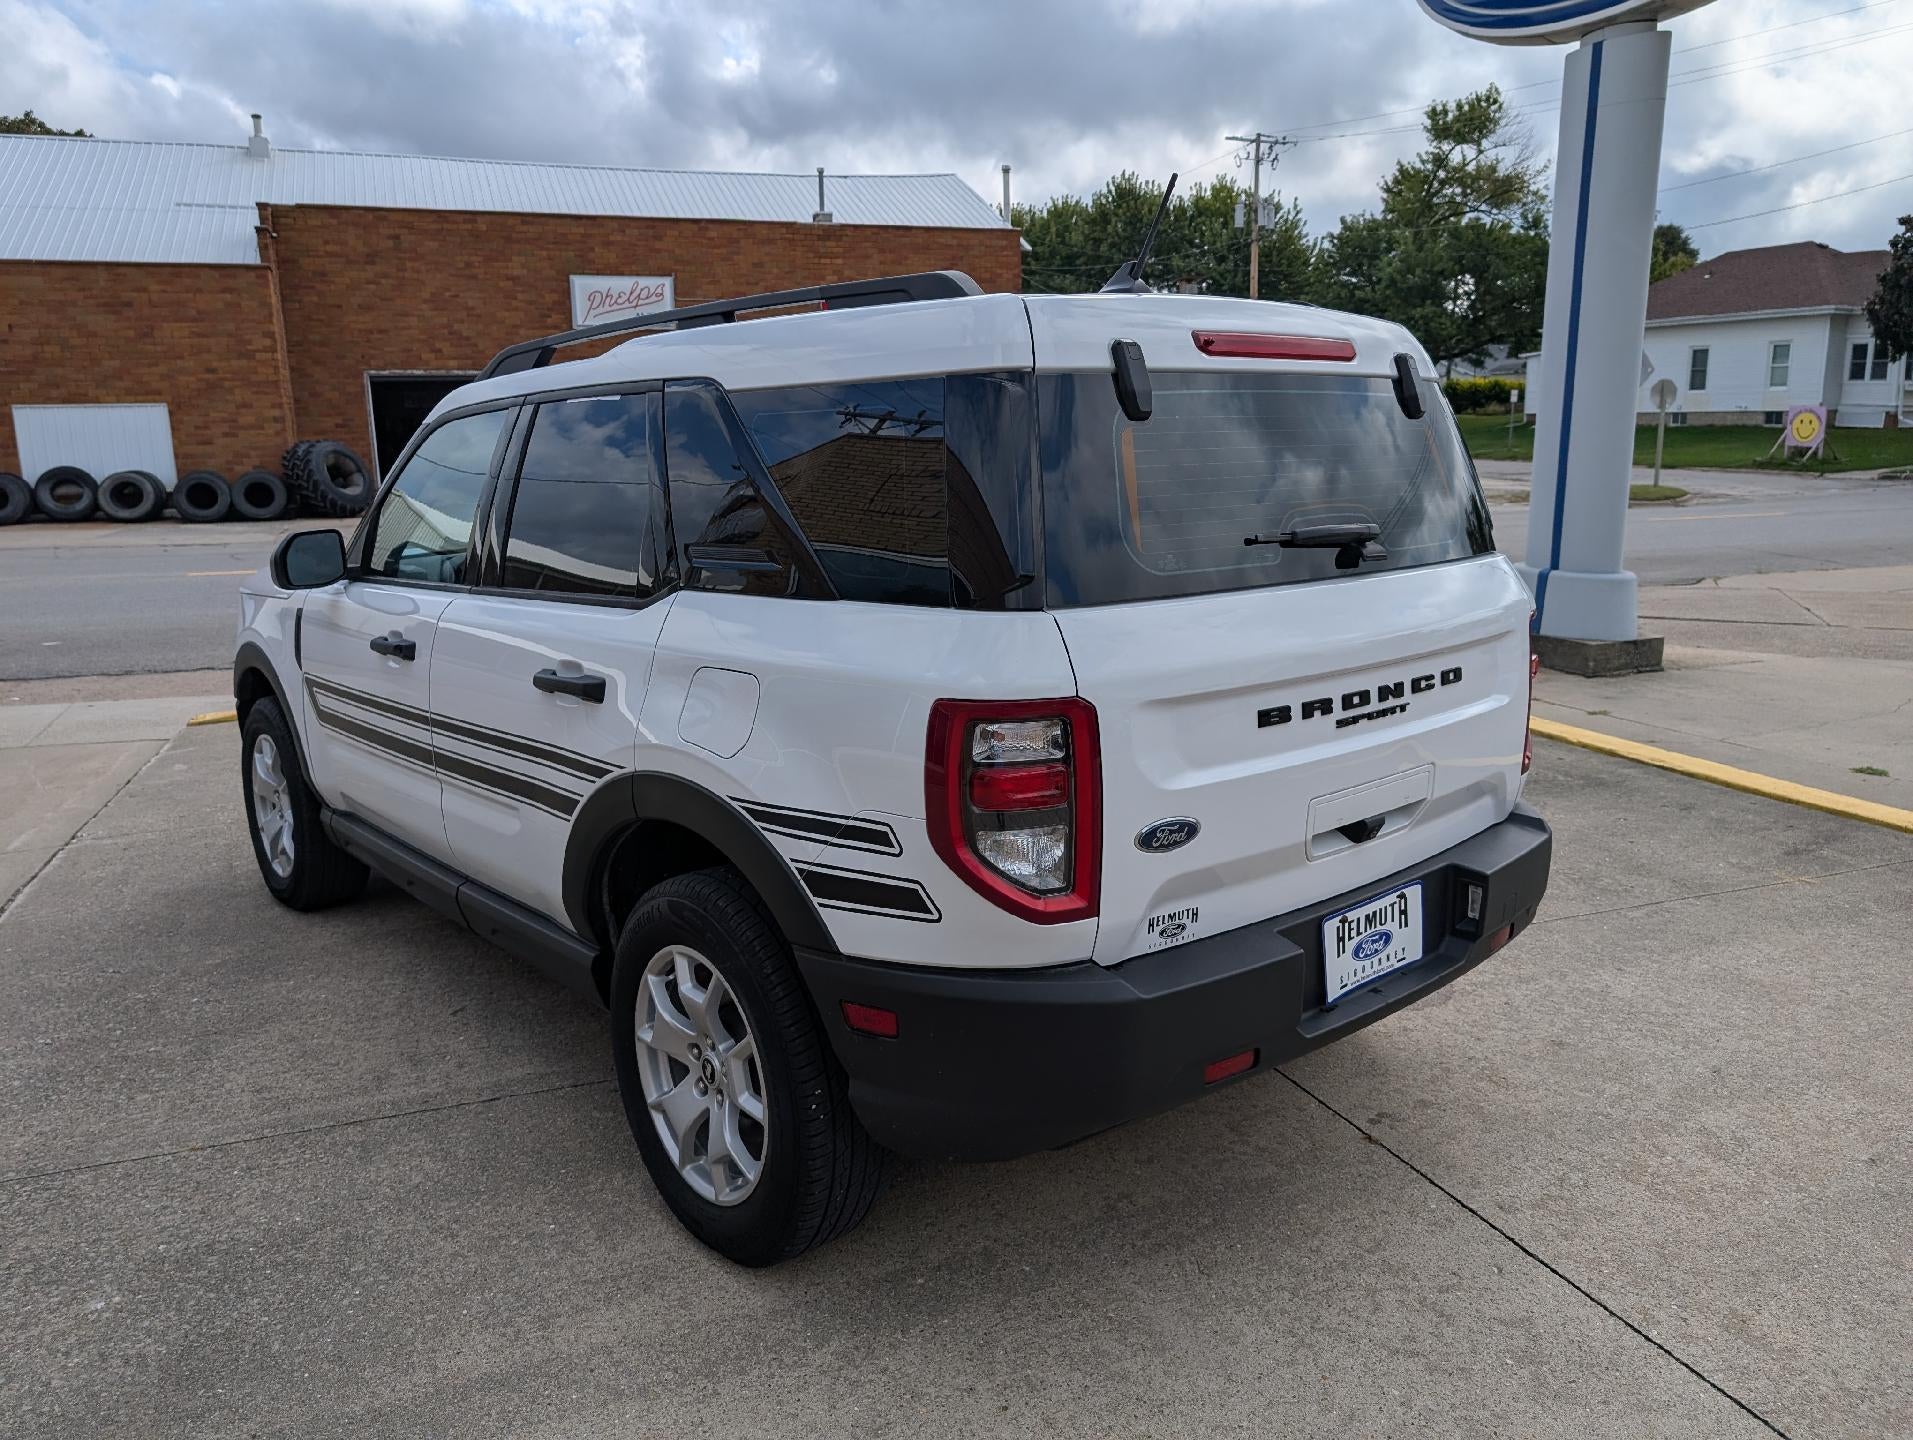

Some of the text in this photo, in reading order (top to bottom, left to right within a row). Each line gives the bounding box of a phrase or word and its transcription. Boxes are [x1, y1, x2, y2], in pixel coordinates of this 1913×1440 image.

[582, 280, 665, 324] Phelps
[1257, 666, 1463, 728] BRONCO
[1335, 702, 1411, 729] SPORT
[1152, 824, 1188, 847] Ford
[1147, 906, 1199, 935] HELMUTH
[1336, 891, 1408, 959] HELMUTH
[1359, 935, 1386, 957] Ford
